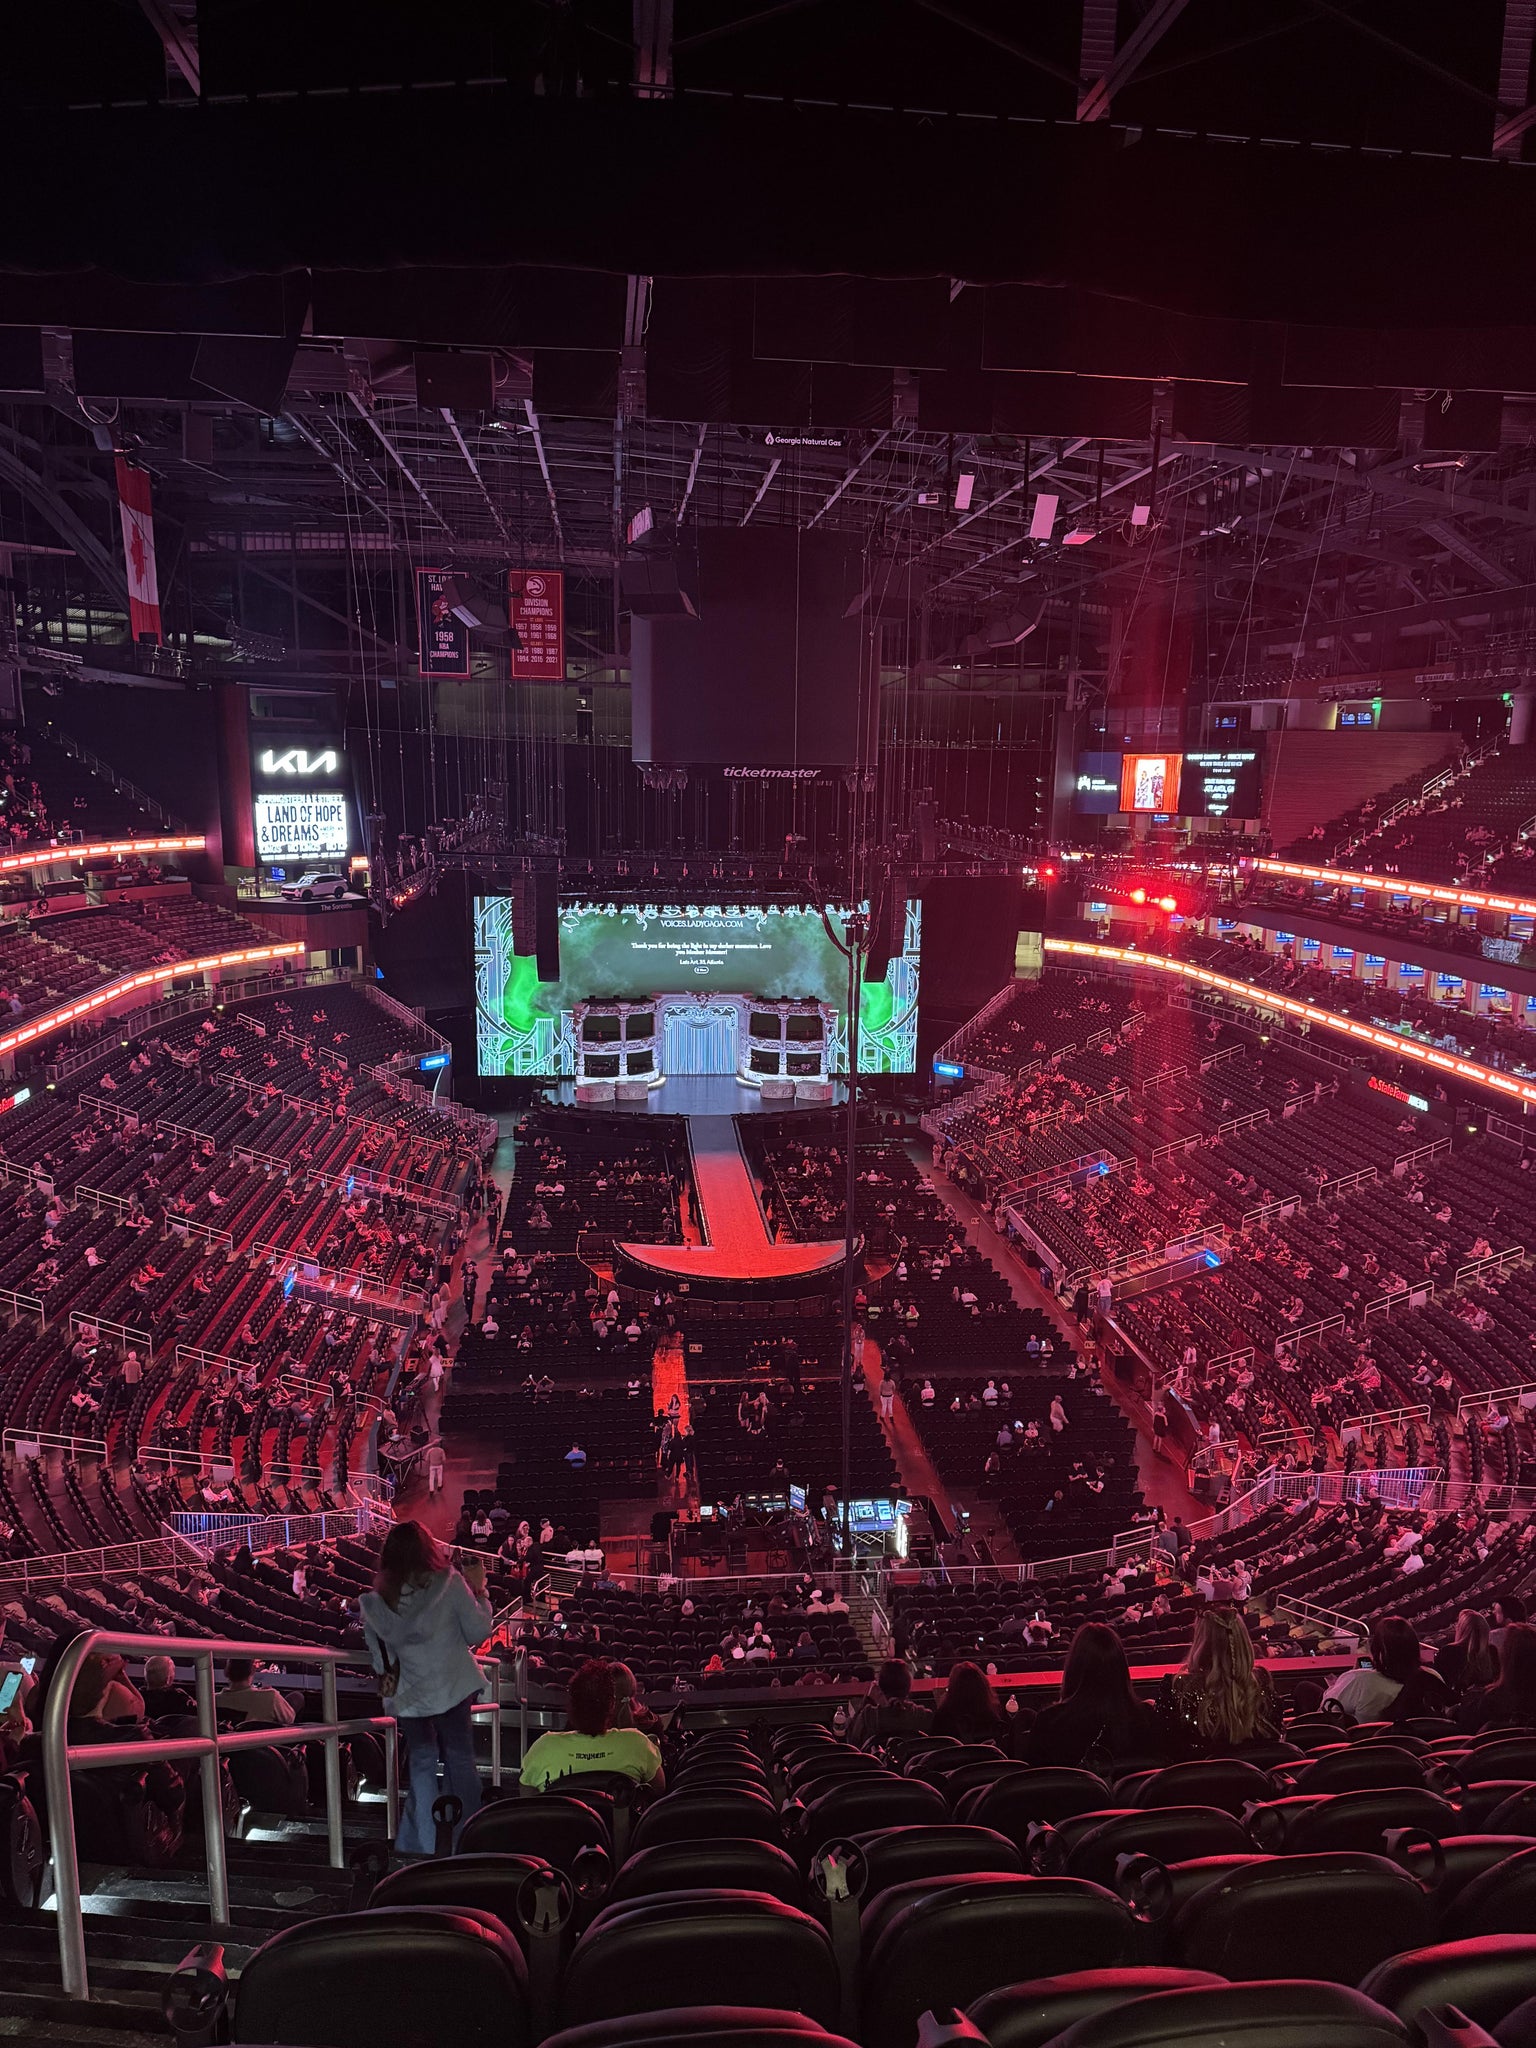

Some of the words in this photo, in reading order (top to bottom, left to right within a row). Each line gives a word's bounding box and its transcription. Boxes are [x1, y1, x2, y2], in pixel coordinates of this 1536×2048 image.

[775, 437, 800, 446] Georgia
[802, 437, 827, 447] Natural
[828, 439, 842, 447] Gas
[520, 607, 553, 616] CHAMPIONS
[434, 631, 454, 642] 1958
[438, 642, 450, 650] NBA
[429, 651, 459, 659] CHAMPIONS
[262, 750, 337, 774] KIA
[723, 766, 822, 778] ticketmaster
[267, 805, 297, 823] LAND
[300, 805, 312, 822] OF
[315, 805, 342, 822] HOPE
[261, 826, 270, 842] &
[271, 824, 319, 842] DREAMS
[660, 920, 744, 928] VOICES.LADYGAGA.COM
